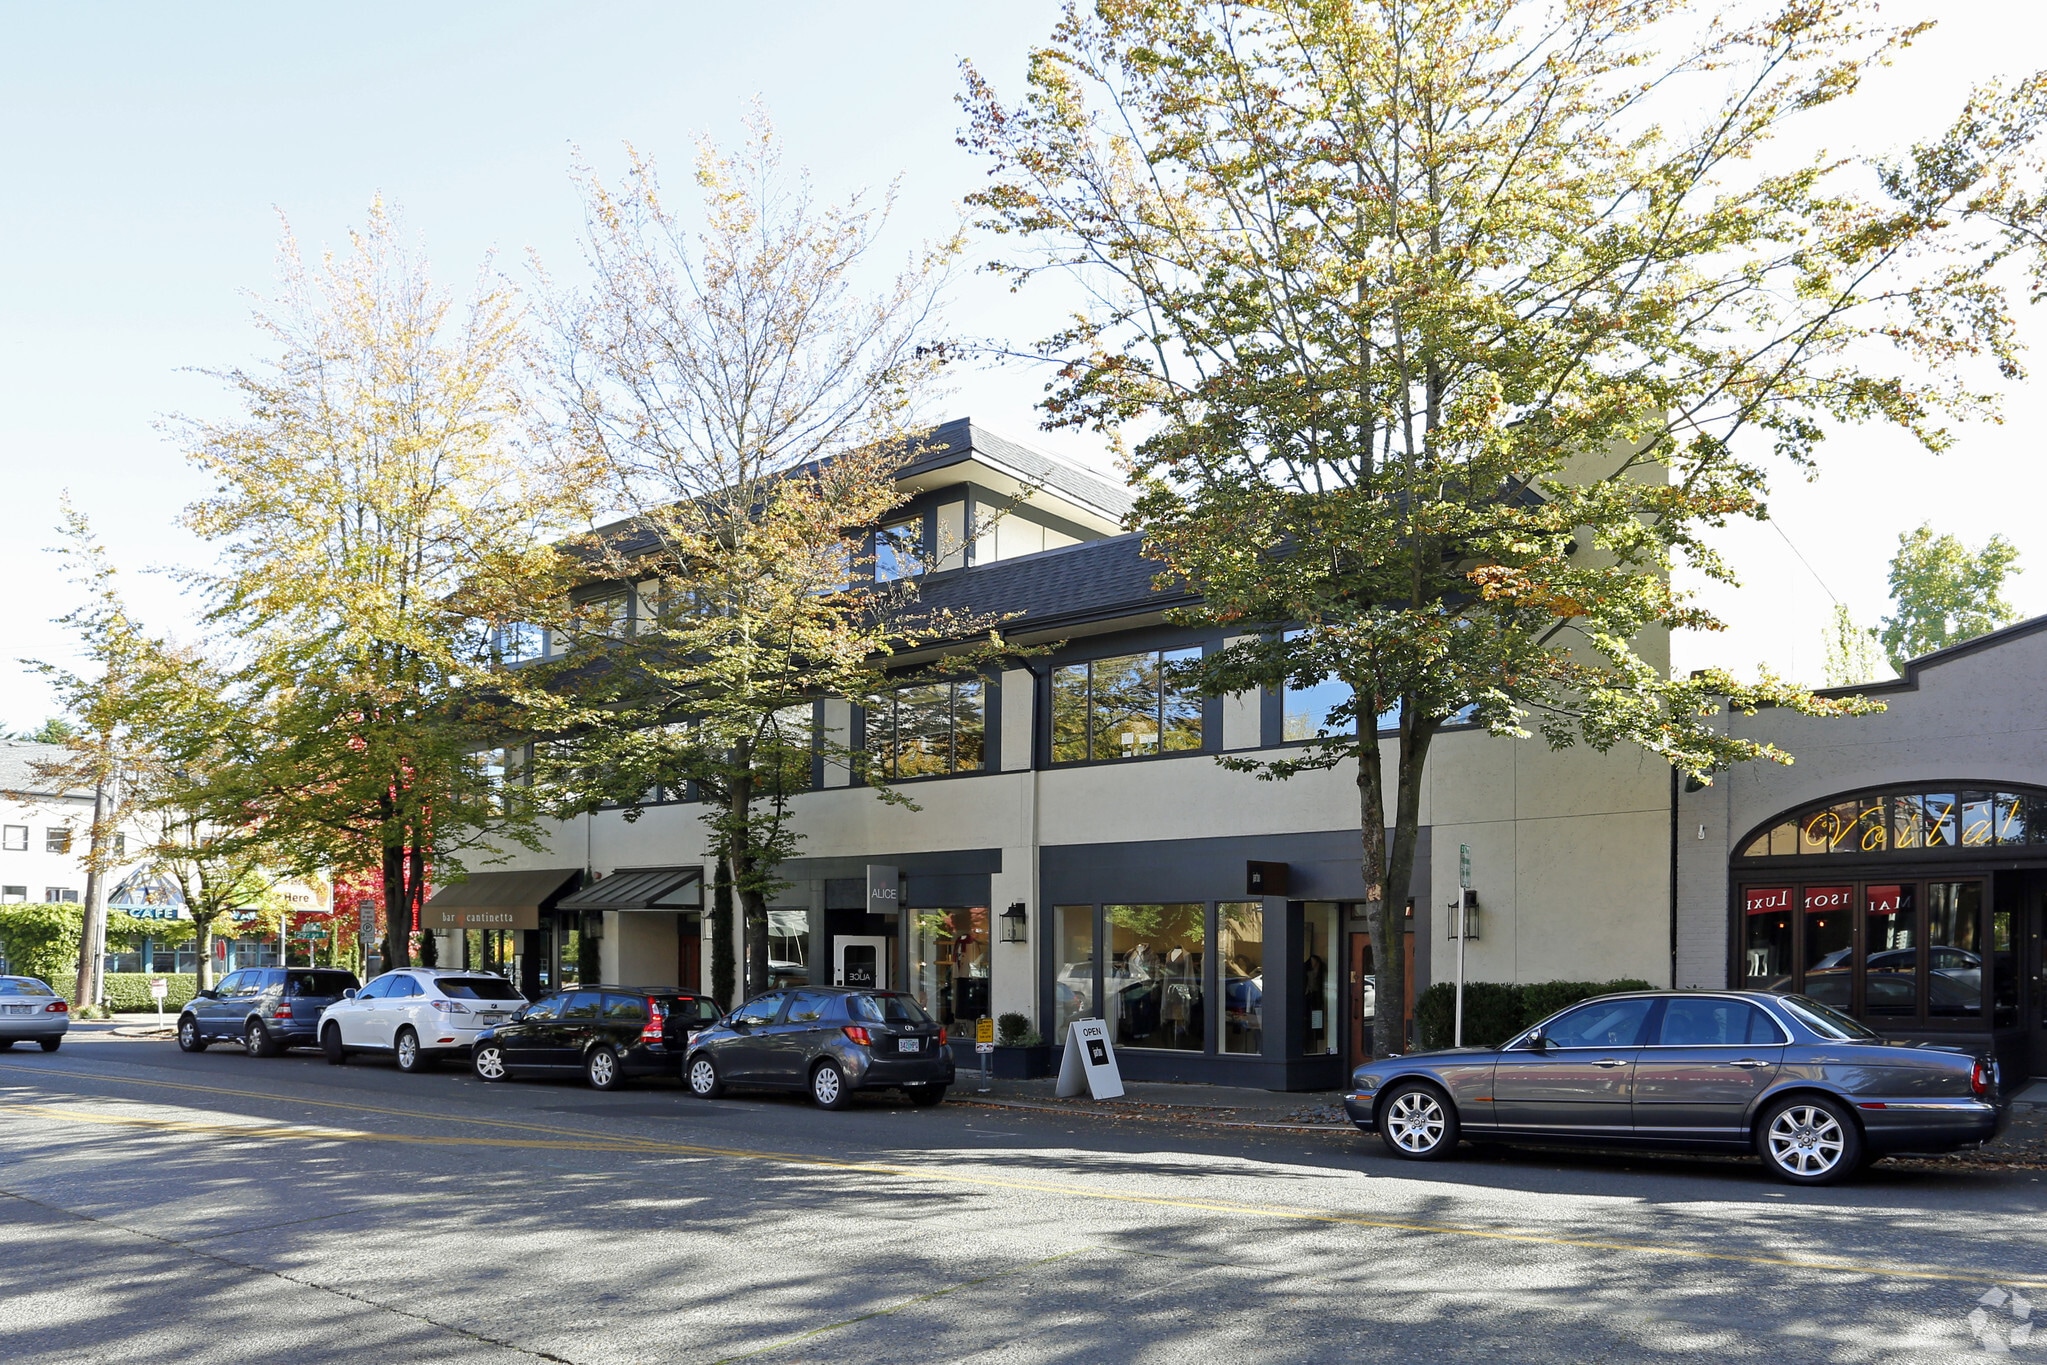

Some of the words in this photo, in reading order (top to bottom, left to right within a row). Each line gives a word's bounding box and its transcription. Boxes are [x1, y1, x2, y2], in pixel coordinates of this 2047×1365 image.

[1805, 800, 2020, 851] Voilà!
[284, 893, 310, 902] Here
[871, 888, 897, 899] ALICE
[129, 908, 173, 918] CAFE
[442, 911, 455, 922] bar
[466, 912, 513, 922] cantinetta
[1083, 1027, 1102, 1037] OPEN
